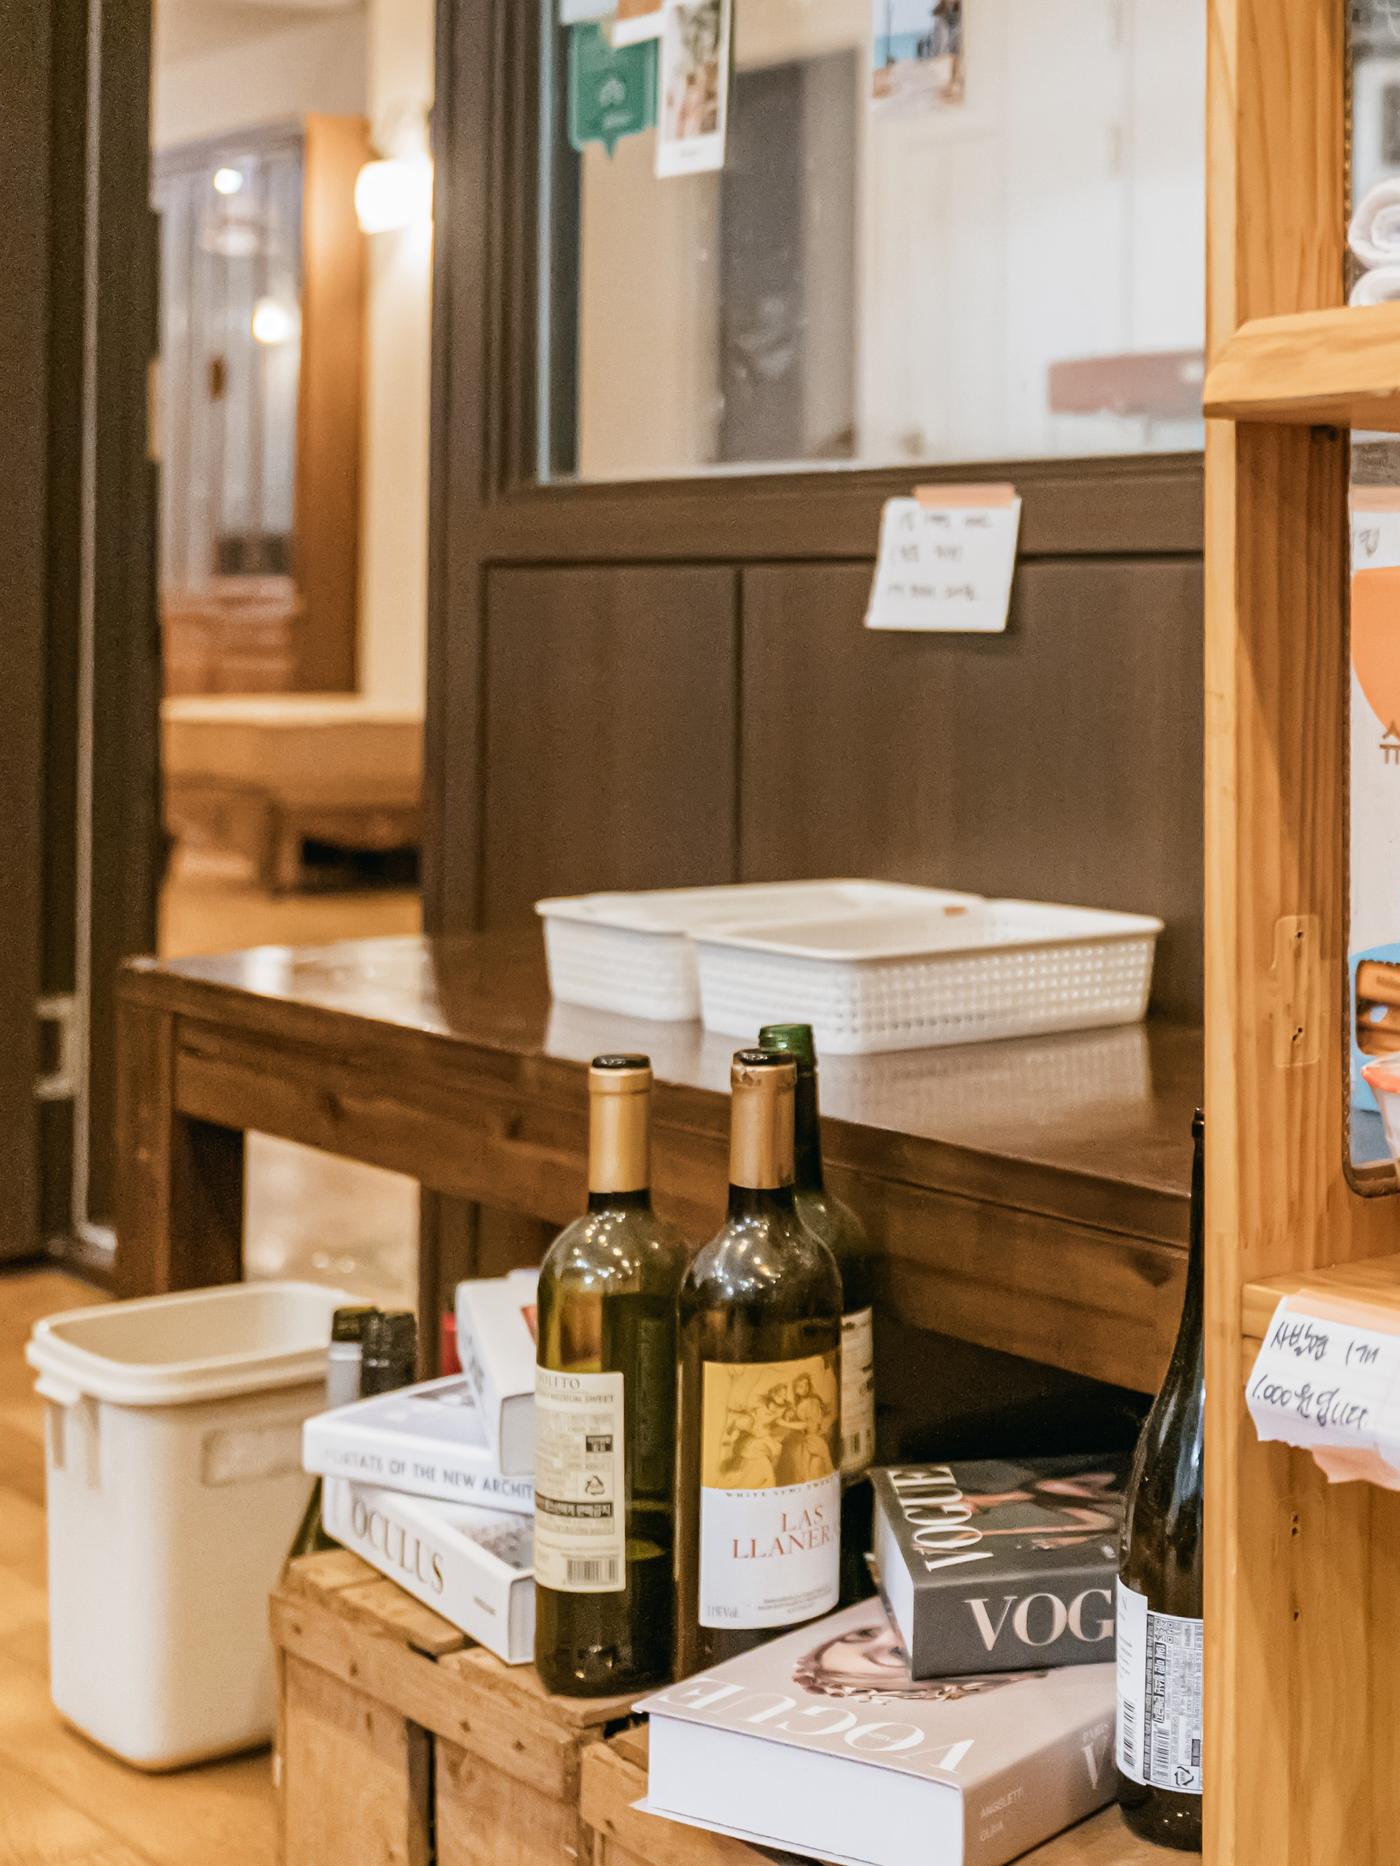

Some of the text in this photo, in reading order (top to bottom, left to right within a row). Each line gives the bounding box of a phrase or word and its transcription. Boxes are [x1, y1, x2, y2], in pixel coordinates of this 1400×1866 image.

[388, 1457, 408, 1476] OF
[413, 1463, 436, 1481] THE
[443, 1470, 477, 1489] NEW
[781, 1504, 824, 1533] LAS
[886, 1466, 995, 1573] VOGUE
[352, 1500, 445, 1594] OCULUS
[654, 1677, 976, 1774] VOGUE
